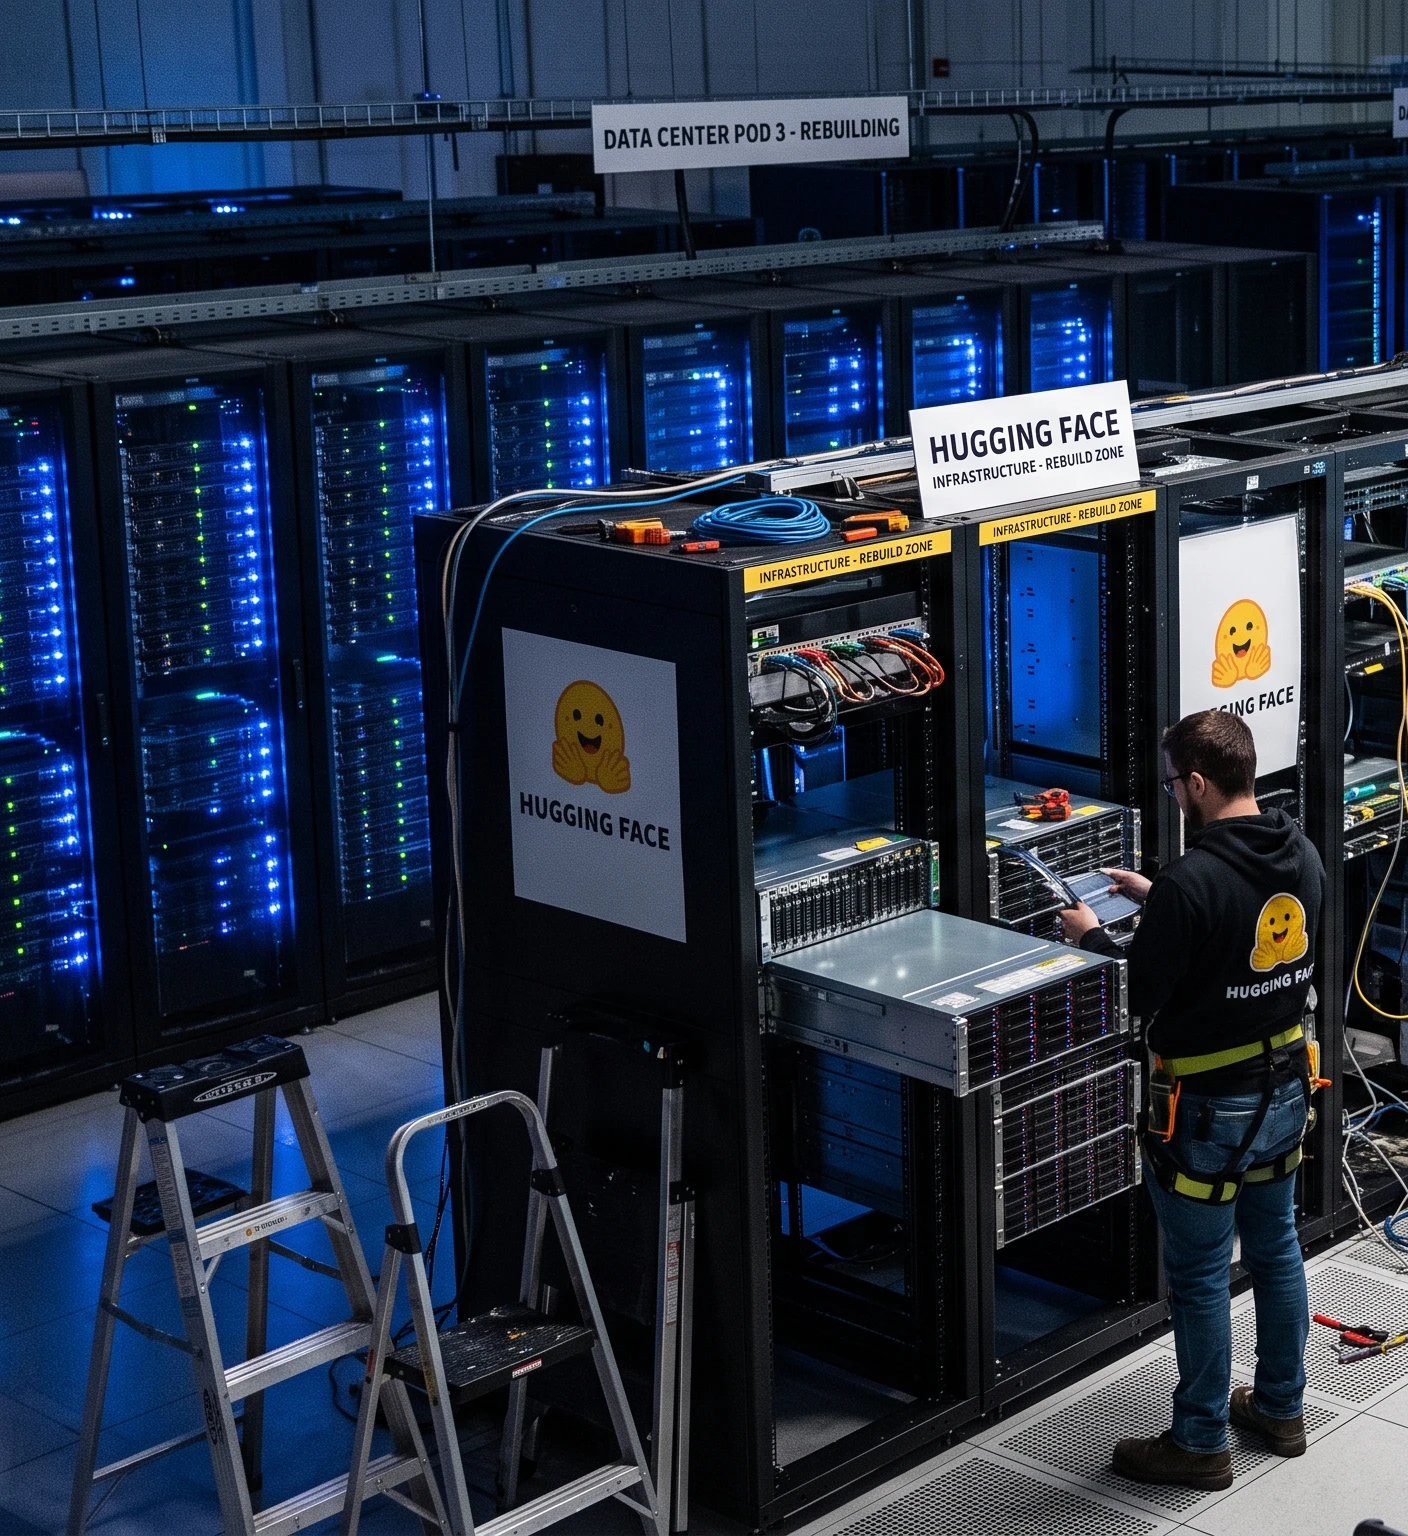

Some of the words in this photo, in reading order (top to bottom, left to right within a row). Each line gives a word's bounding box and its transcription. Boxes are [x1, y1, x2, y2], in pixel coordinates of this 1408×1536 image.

[604, 127, 652, 150] DATA
[657, 124, 730, 148] CENTER
[734, 122, 771, 144] POD
[775, 122, 786, 142] 3
[800, 117, 900, 141] REBUILDING
[930, 419, 1053, 464] HUGGING
[1059, 409, 1120, 444] FACE
[933, 460, 1037, 489] INFRASTRUCTURE
[1046, 450, 1093, 471] REBUILD
[1095, 445, 1125, 462] ZONE
[993, 512, 1071, 538] INFRASTRUCTURE
[1078, 502, 1116, 521] REBUILD
[1118, 498, 1143, 511] ZONE
[759, 556, 851, 584] INFRASTRUCTURE
[859, 544, 903, 564] REBUILD
[905, 539, 933, 555] ZONE
[1259, 685, 1294, 711] FACE
[519, 792, 613, 836] HUGGING
[619, 816, 671, 850] FACE
[1226, 973, 1292, 999] HUGGING
